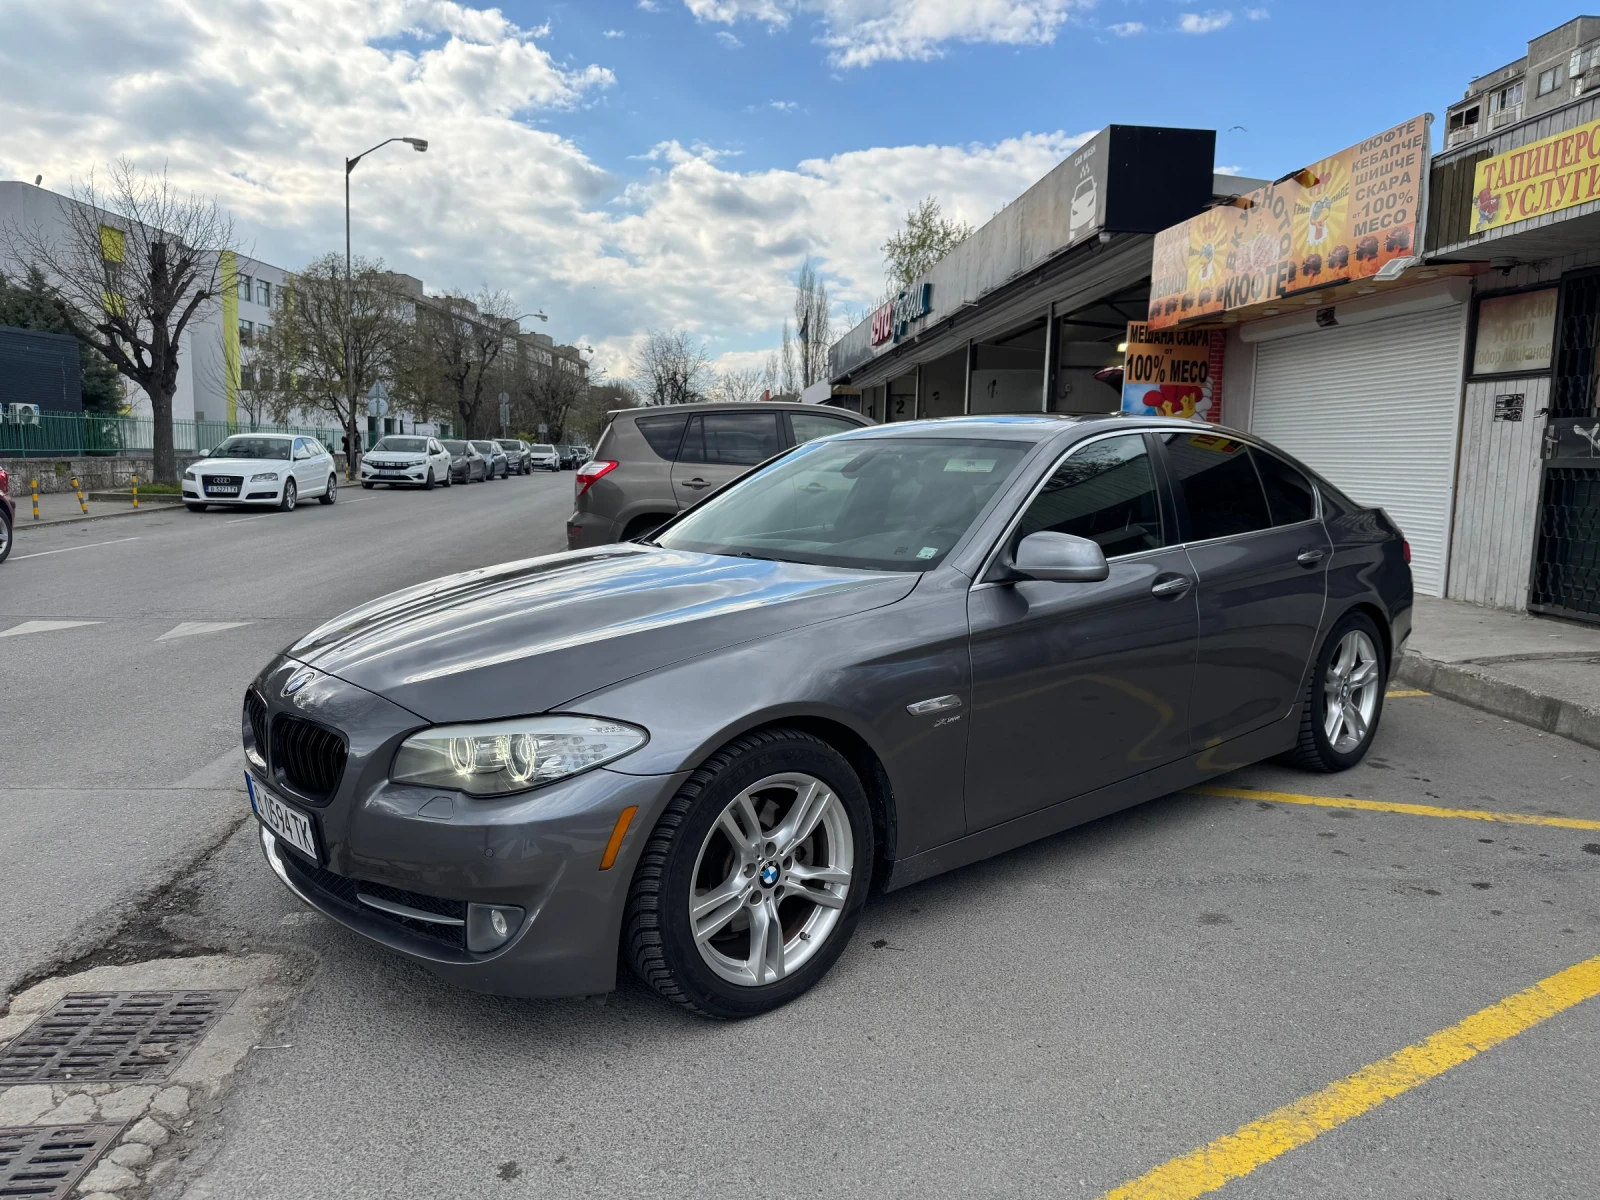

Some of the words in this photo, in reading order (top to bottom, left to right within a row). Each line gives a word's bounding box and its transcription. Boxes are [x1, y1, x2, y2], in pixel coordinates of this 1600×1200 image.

[1360, 121, 1416, 155] КЮФТЕ
[1074, 154, 1083, 167] CAR
[1352, 134, 1423, 172] КЕБАПЧЕ
[1355, 153, 1415, 186] ШИШЧЕ
[1355, 171, 1411, 201] СКАРА
[1361, 189, 1413, 217] 100%
[1353, 208, 1407, 237] МЕСО
[1224, 260, 1289, 309] КЮФТЕ
[1126, 354, 1166, 383] 100%
[1169, 359, 1208, 383] МЕСО
[896, 400, 905, 414] 2
